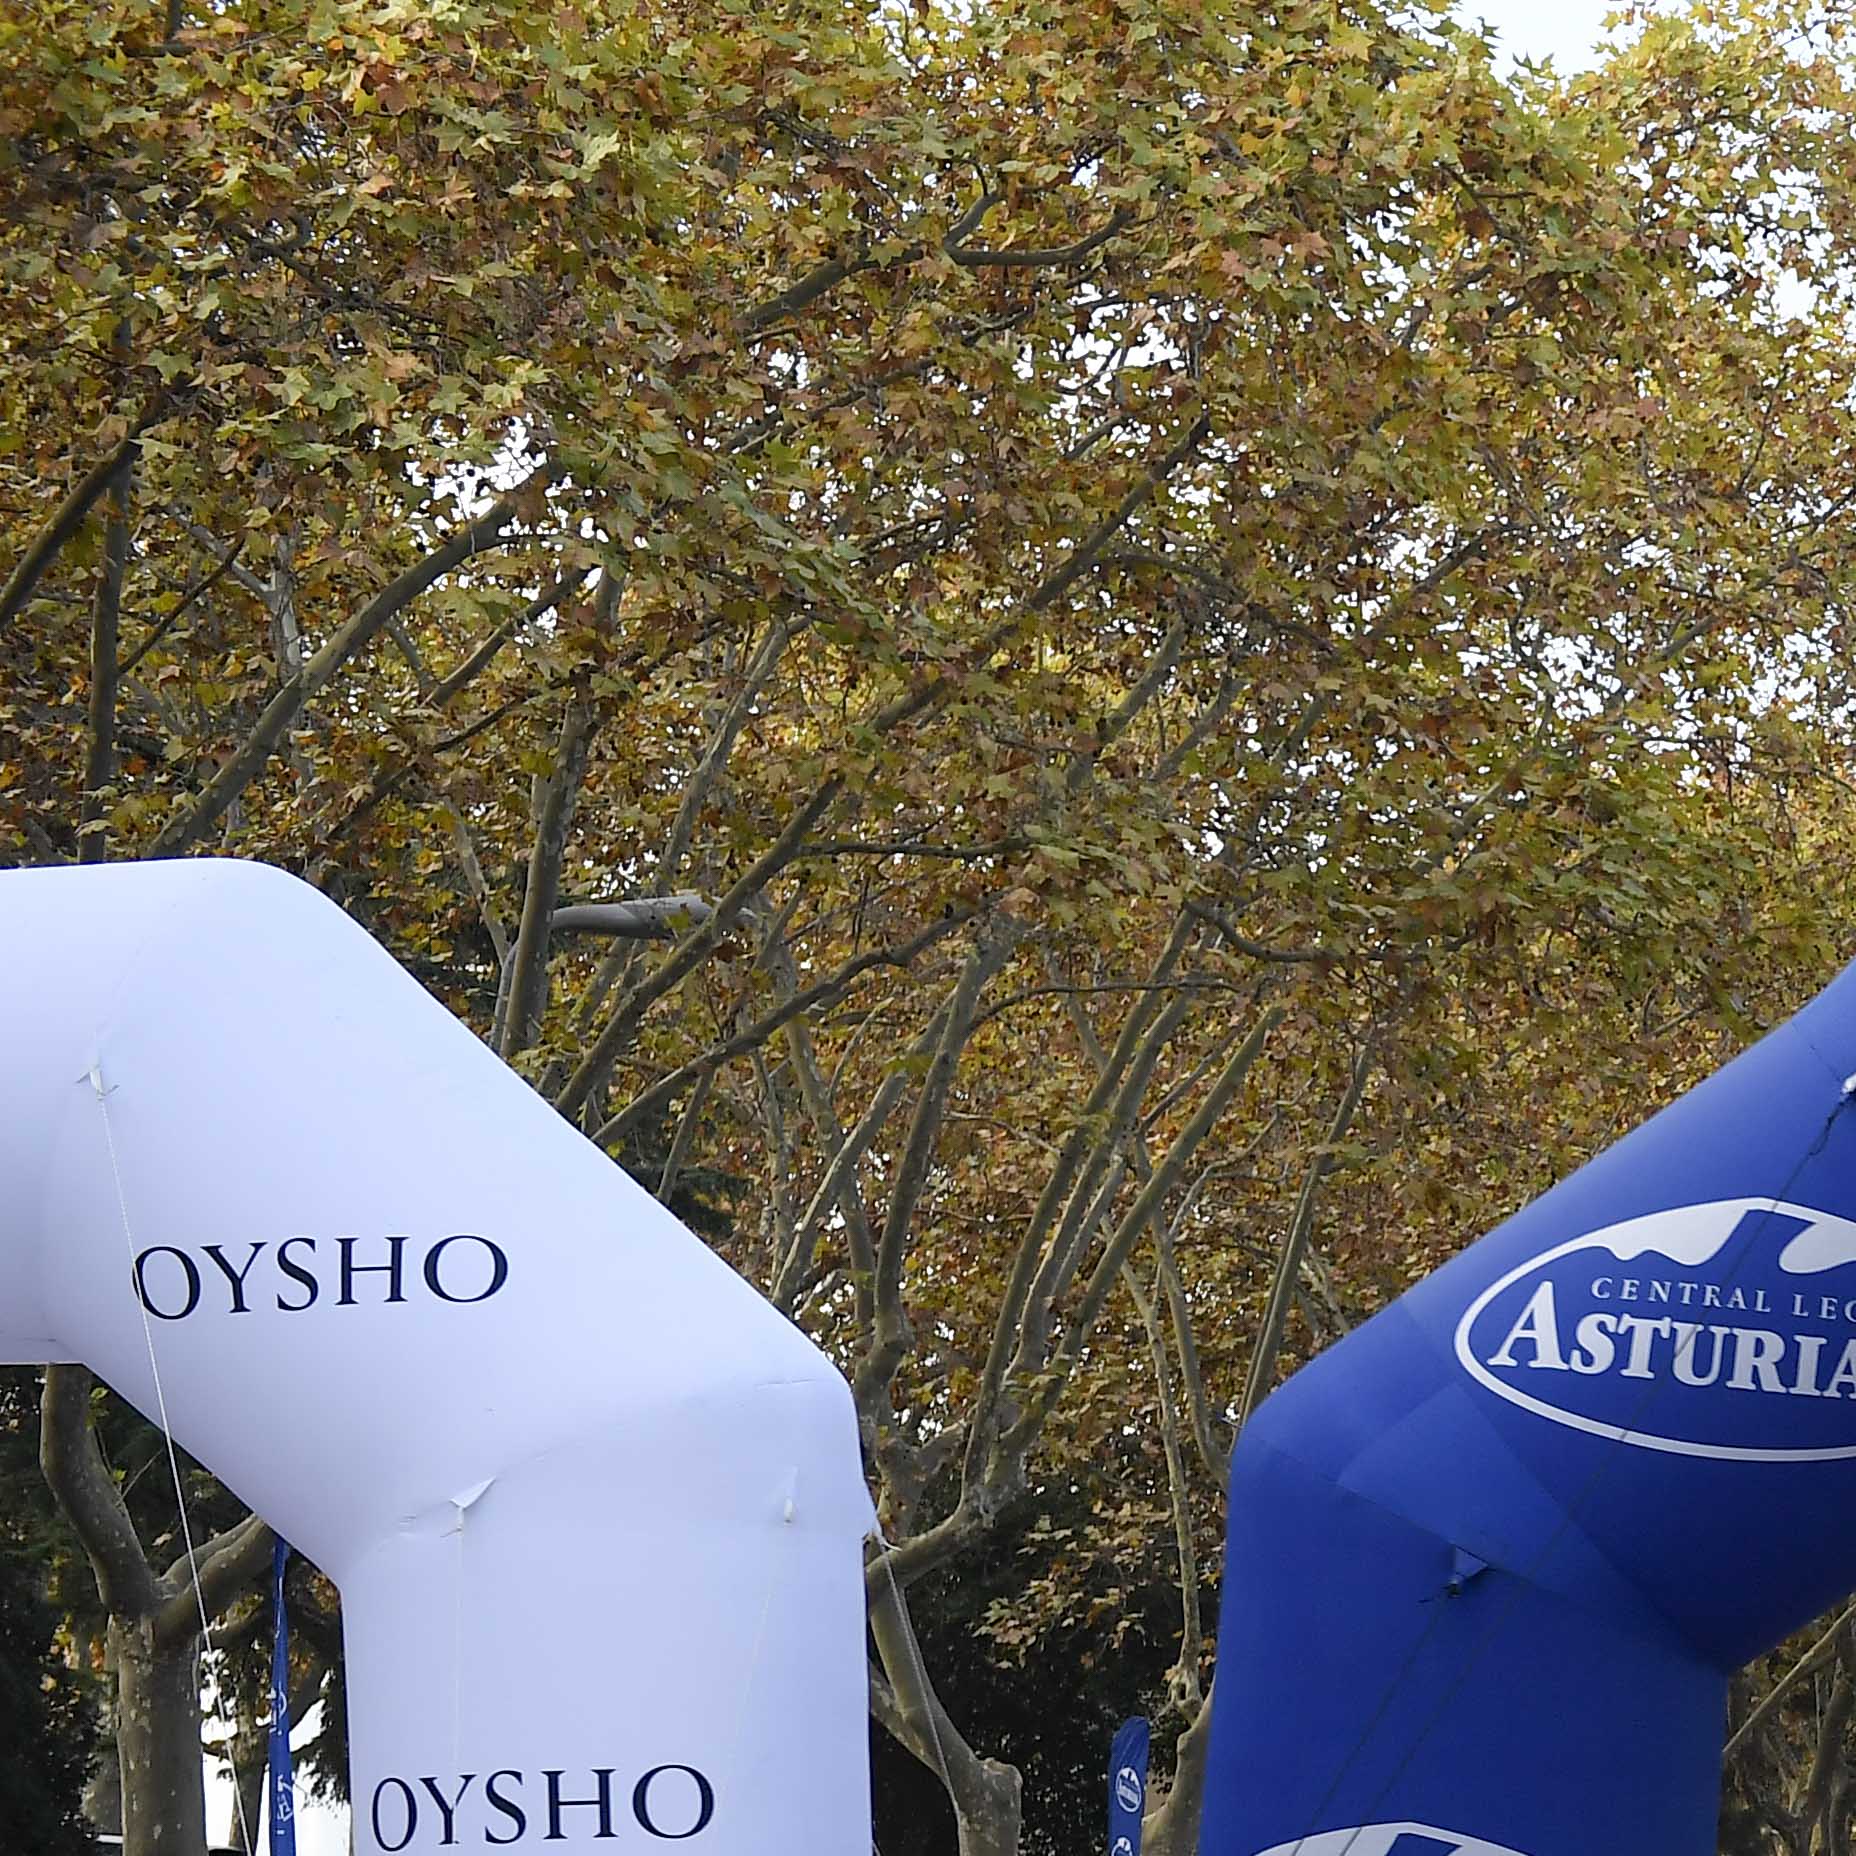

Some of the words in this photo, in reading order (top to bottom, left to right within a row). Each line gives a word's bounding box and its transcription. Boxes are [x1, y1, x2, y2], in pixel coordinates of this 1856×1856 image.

[131, 1235, 508, 1319] OYSHO
[1590, 1277, 1772, 1312] CENTRAL
[371, 1764, 715, 1852] OYSHO
